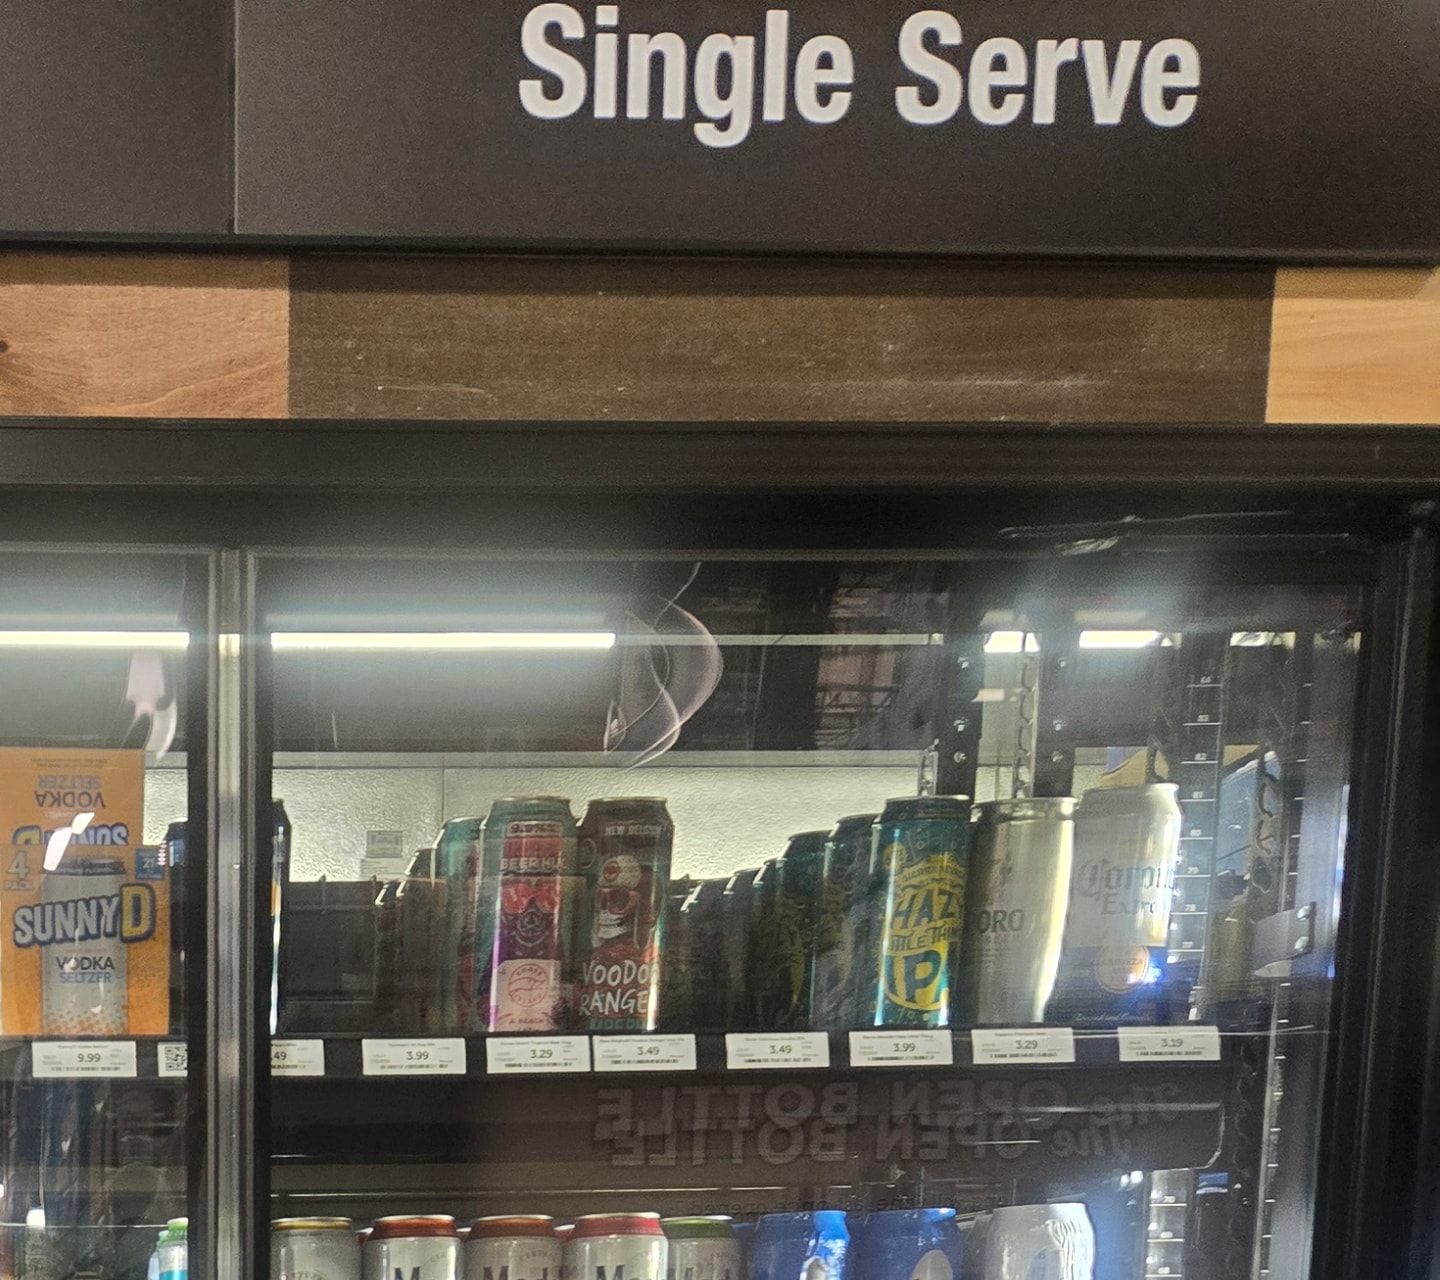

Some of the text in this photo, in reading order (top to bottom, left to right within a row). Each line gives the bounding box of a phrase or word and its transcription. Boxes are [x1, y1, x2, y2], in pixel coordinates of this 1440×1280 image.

[517, 2, 1201, 148] Single Serve
[7, 851, 28, 879] 4
[56, 955, 115, 972] VODKA
[60, 971, 113, 984] SELTZER
[77, 1052, 102, 1063] 9.99
[406, 1050, 430, 1061] 3.99
[530, 1048, 554, 1059] 3.29
